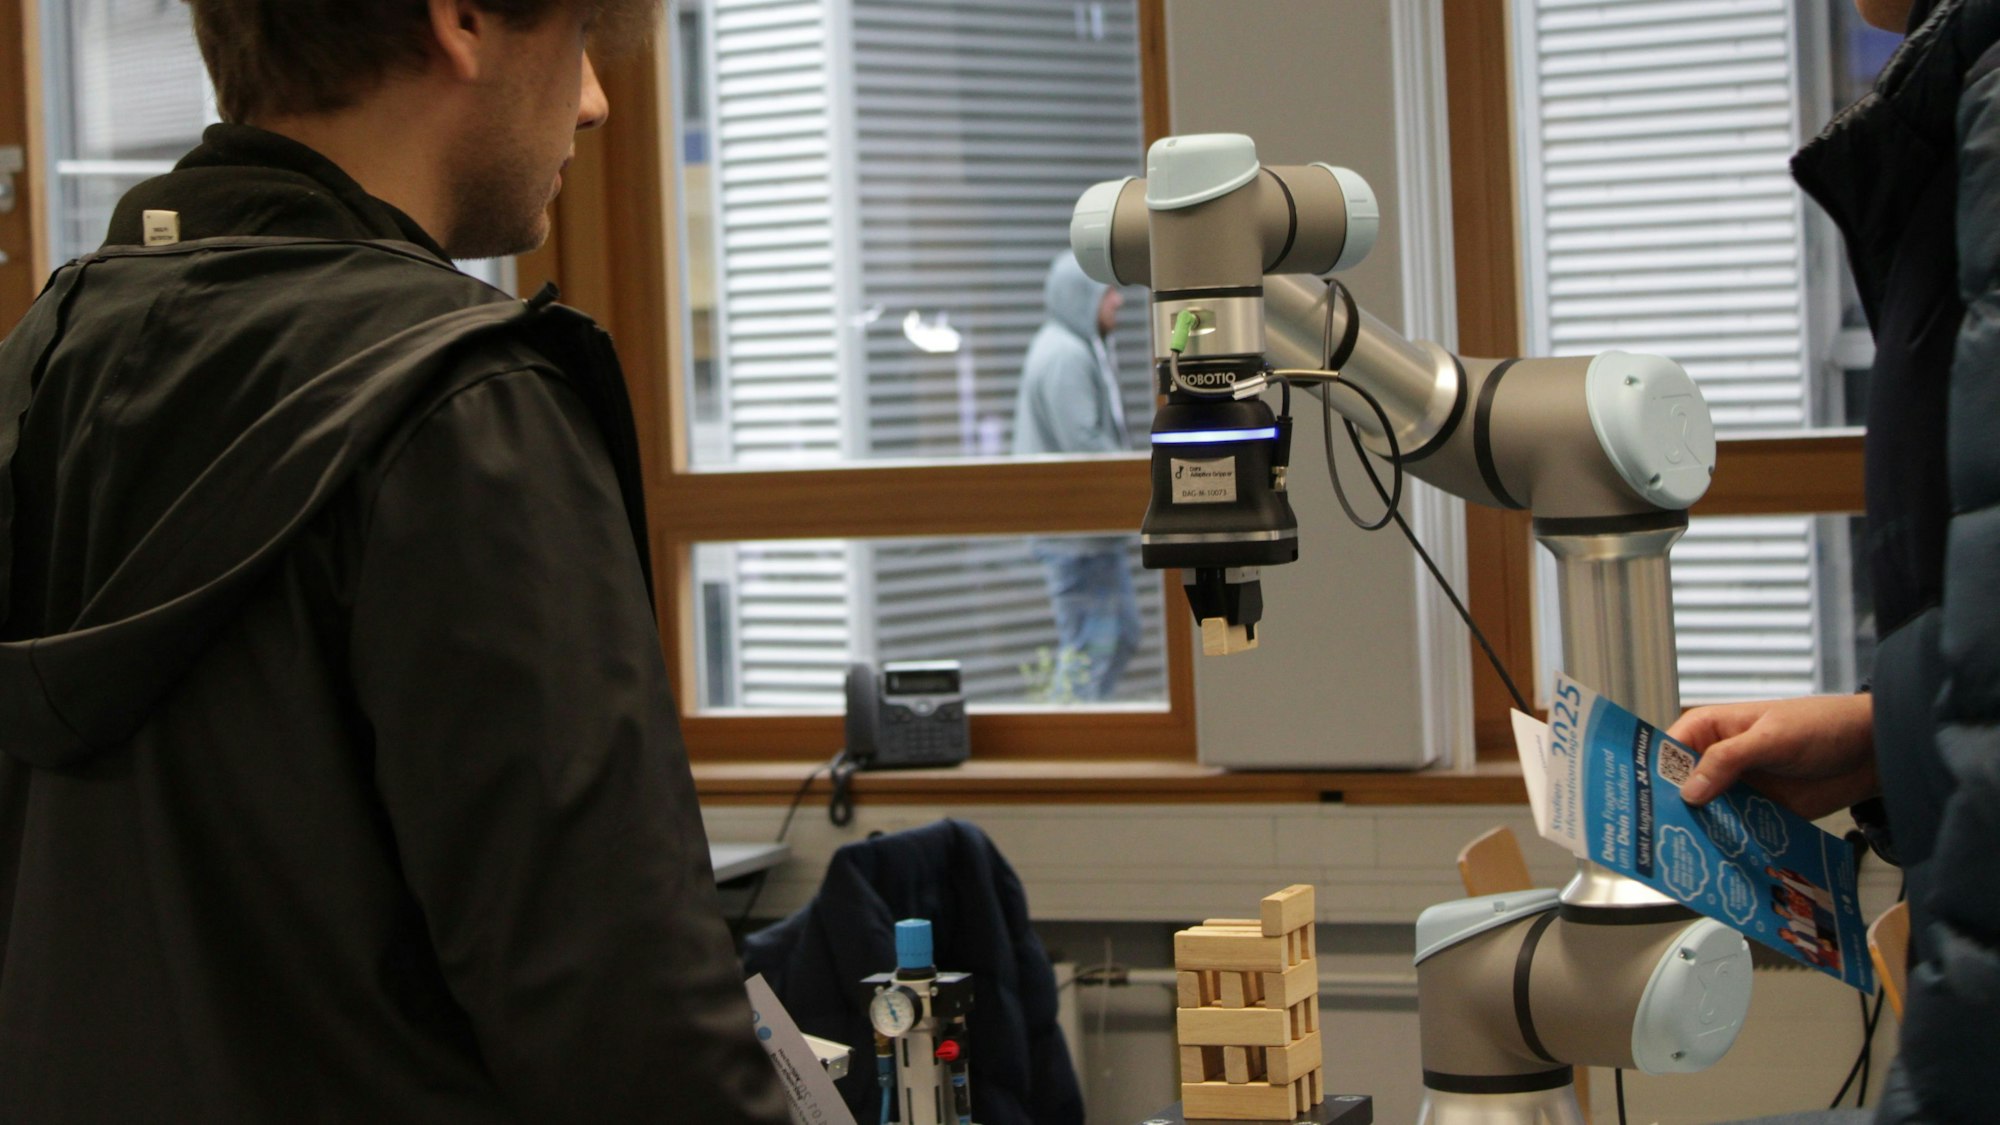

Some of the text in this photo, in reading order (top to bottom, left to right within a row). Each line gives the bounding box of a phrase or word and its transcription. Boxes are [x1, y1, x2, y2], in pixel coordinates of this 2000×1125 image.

[1180, 371, 1236, 386] ROBOTIQ
[1551, 678, 1581, 757] 2025
[1635, 727, 1650, 767] Januar
[1601, 747, 1619, 862] Deine Fragen rund
[1616, 762, 1631, 870] um Dein Studium
[1637, 836, 1651, 868] Sankt
